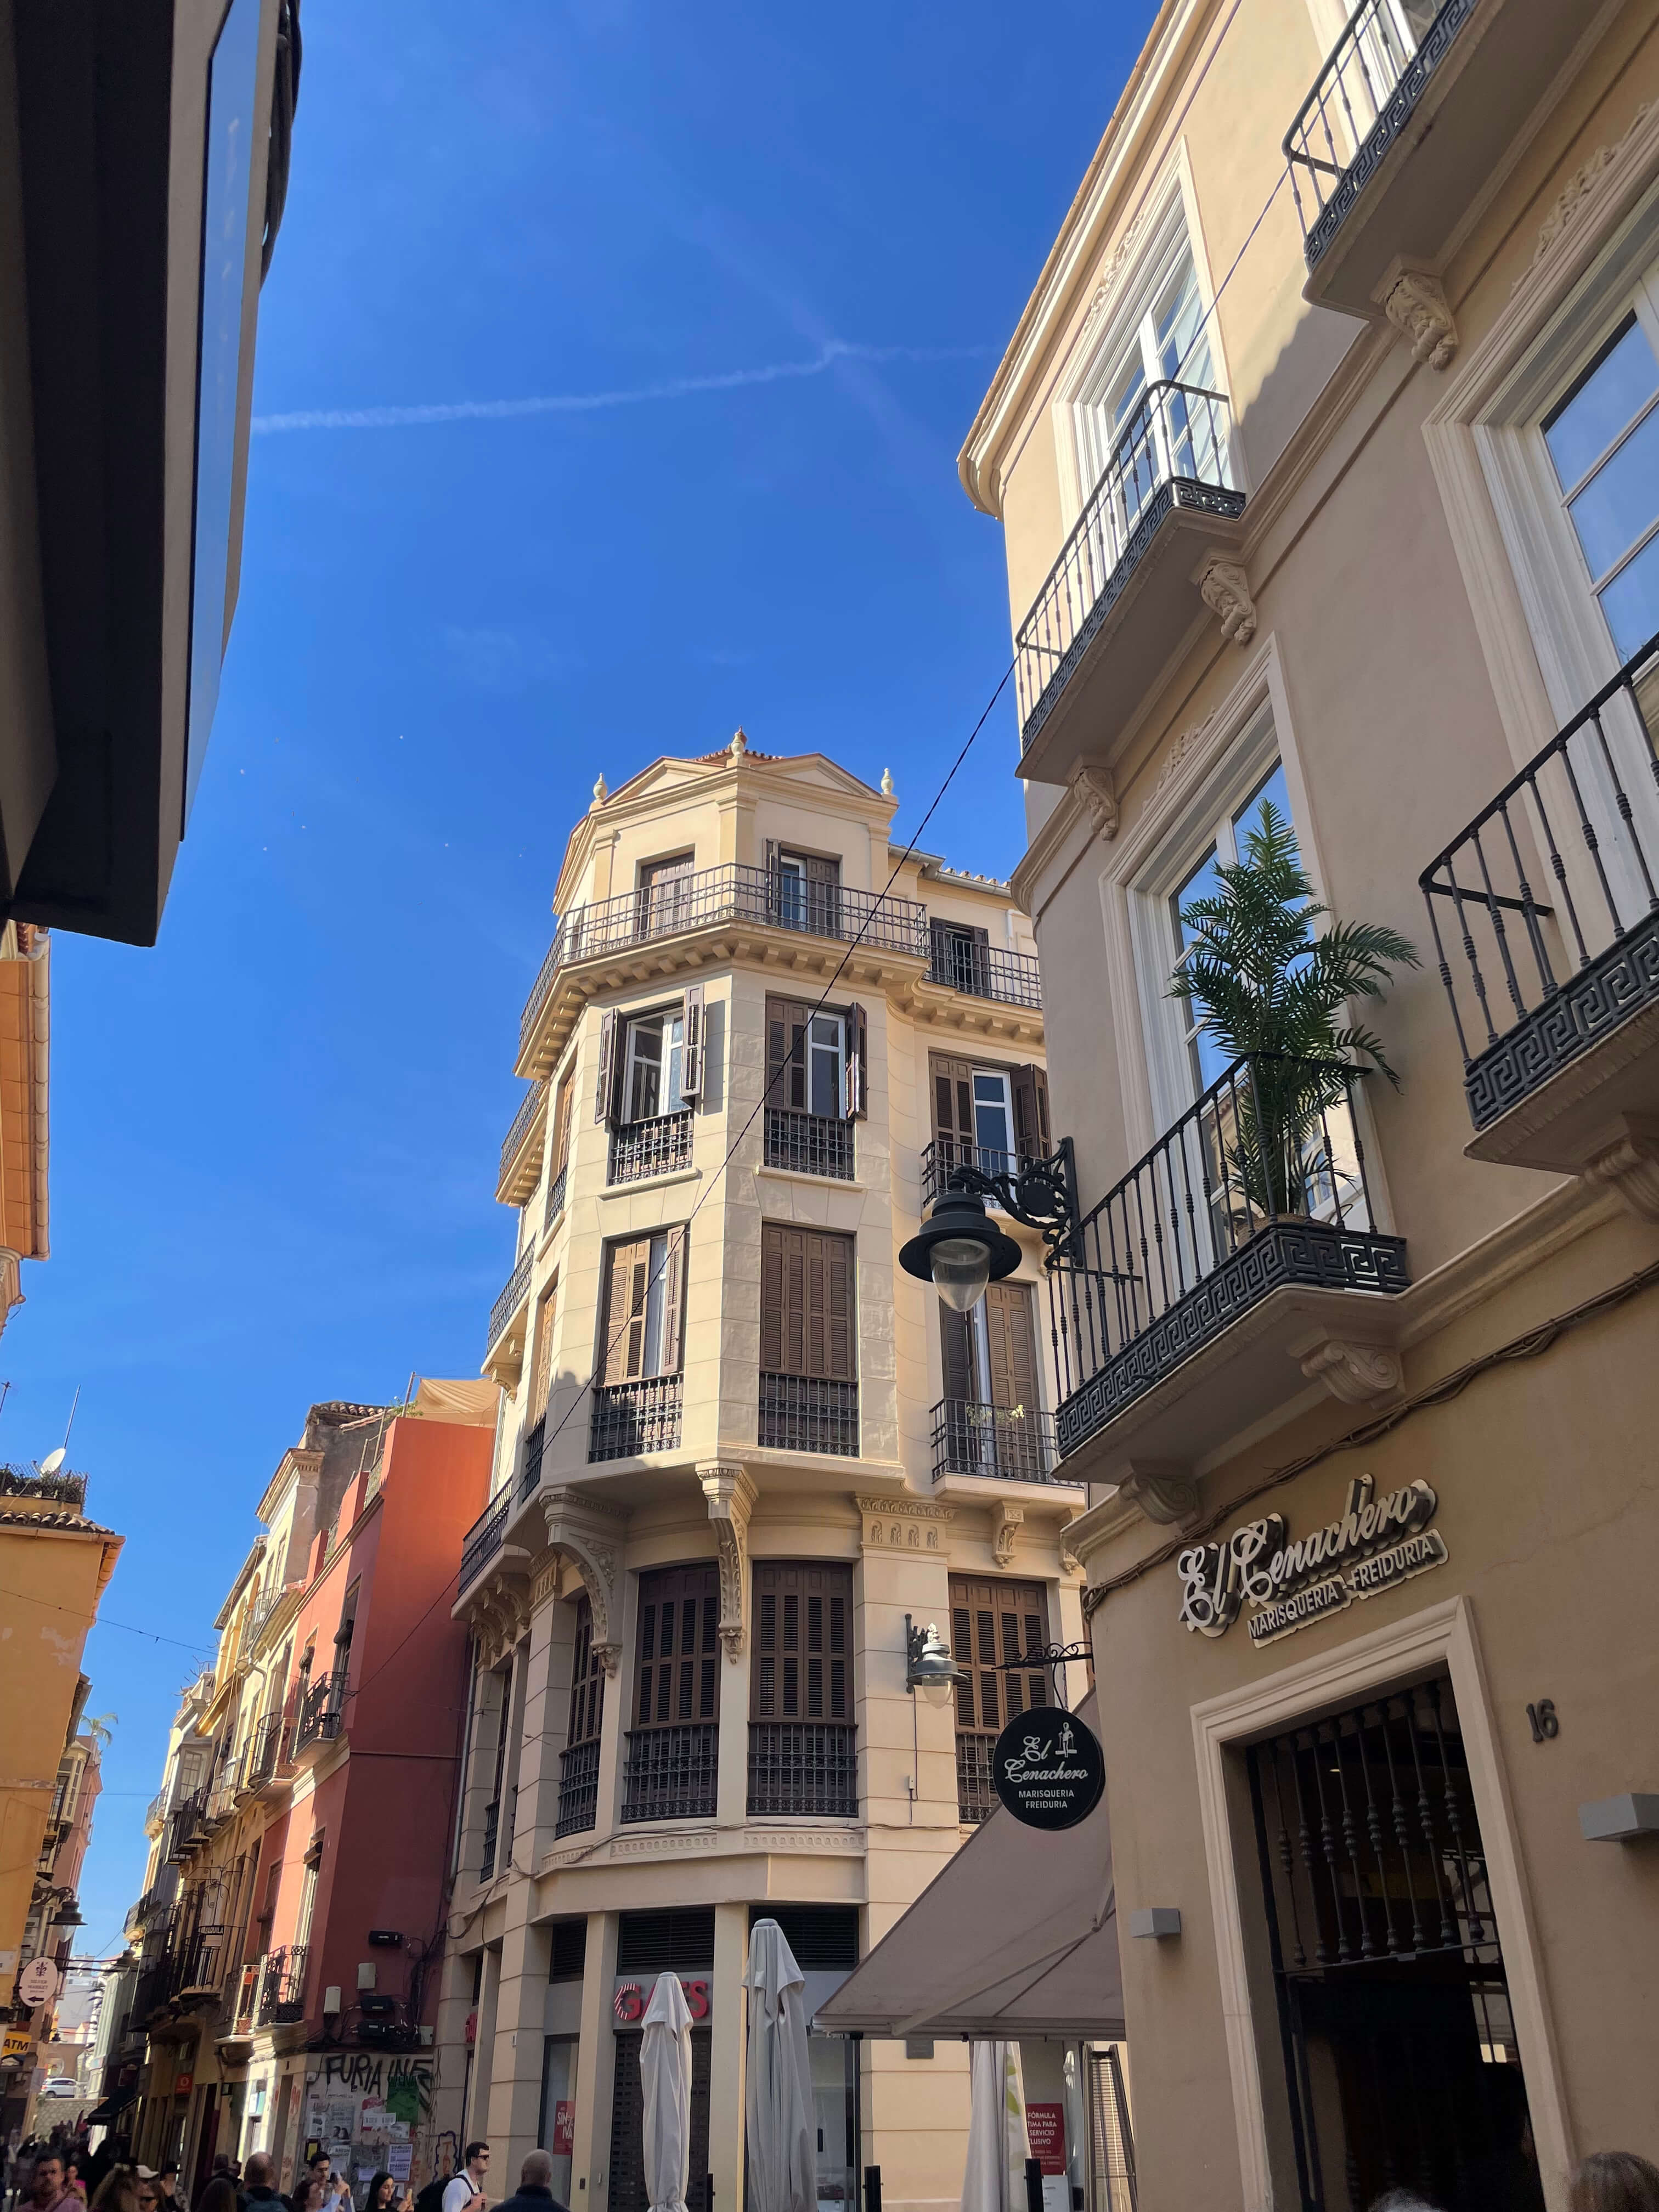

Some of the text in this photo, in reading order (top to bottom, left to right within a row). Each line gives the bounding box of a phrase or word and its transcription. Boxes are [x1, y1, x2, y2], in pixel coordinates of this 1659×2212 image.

[1178, 1479, 1417, 1627] El Cenachero
[1247, 1581, 1339, 1640] MARISQUERIA
[1350, 1537, 1434, 1591] FREIDURIA
[1526, 1699, 1558, 1742] 16
[1020, 1736, 1052, 1761] El
[1004, 1759, 1088, 1783] Cenachero
[1018, 1790, 1074, 1798] MARISQUERIA
[1026, 1801, 1068, 1809] FREIDURIA
[614, 1980, 707, 2020] GS
[4, 2038, 29, 2051] ATM
